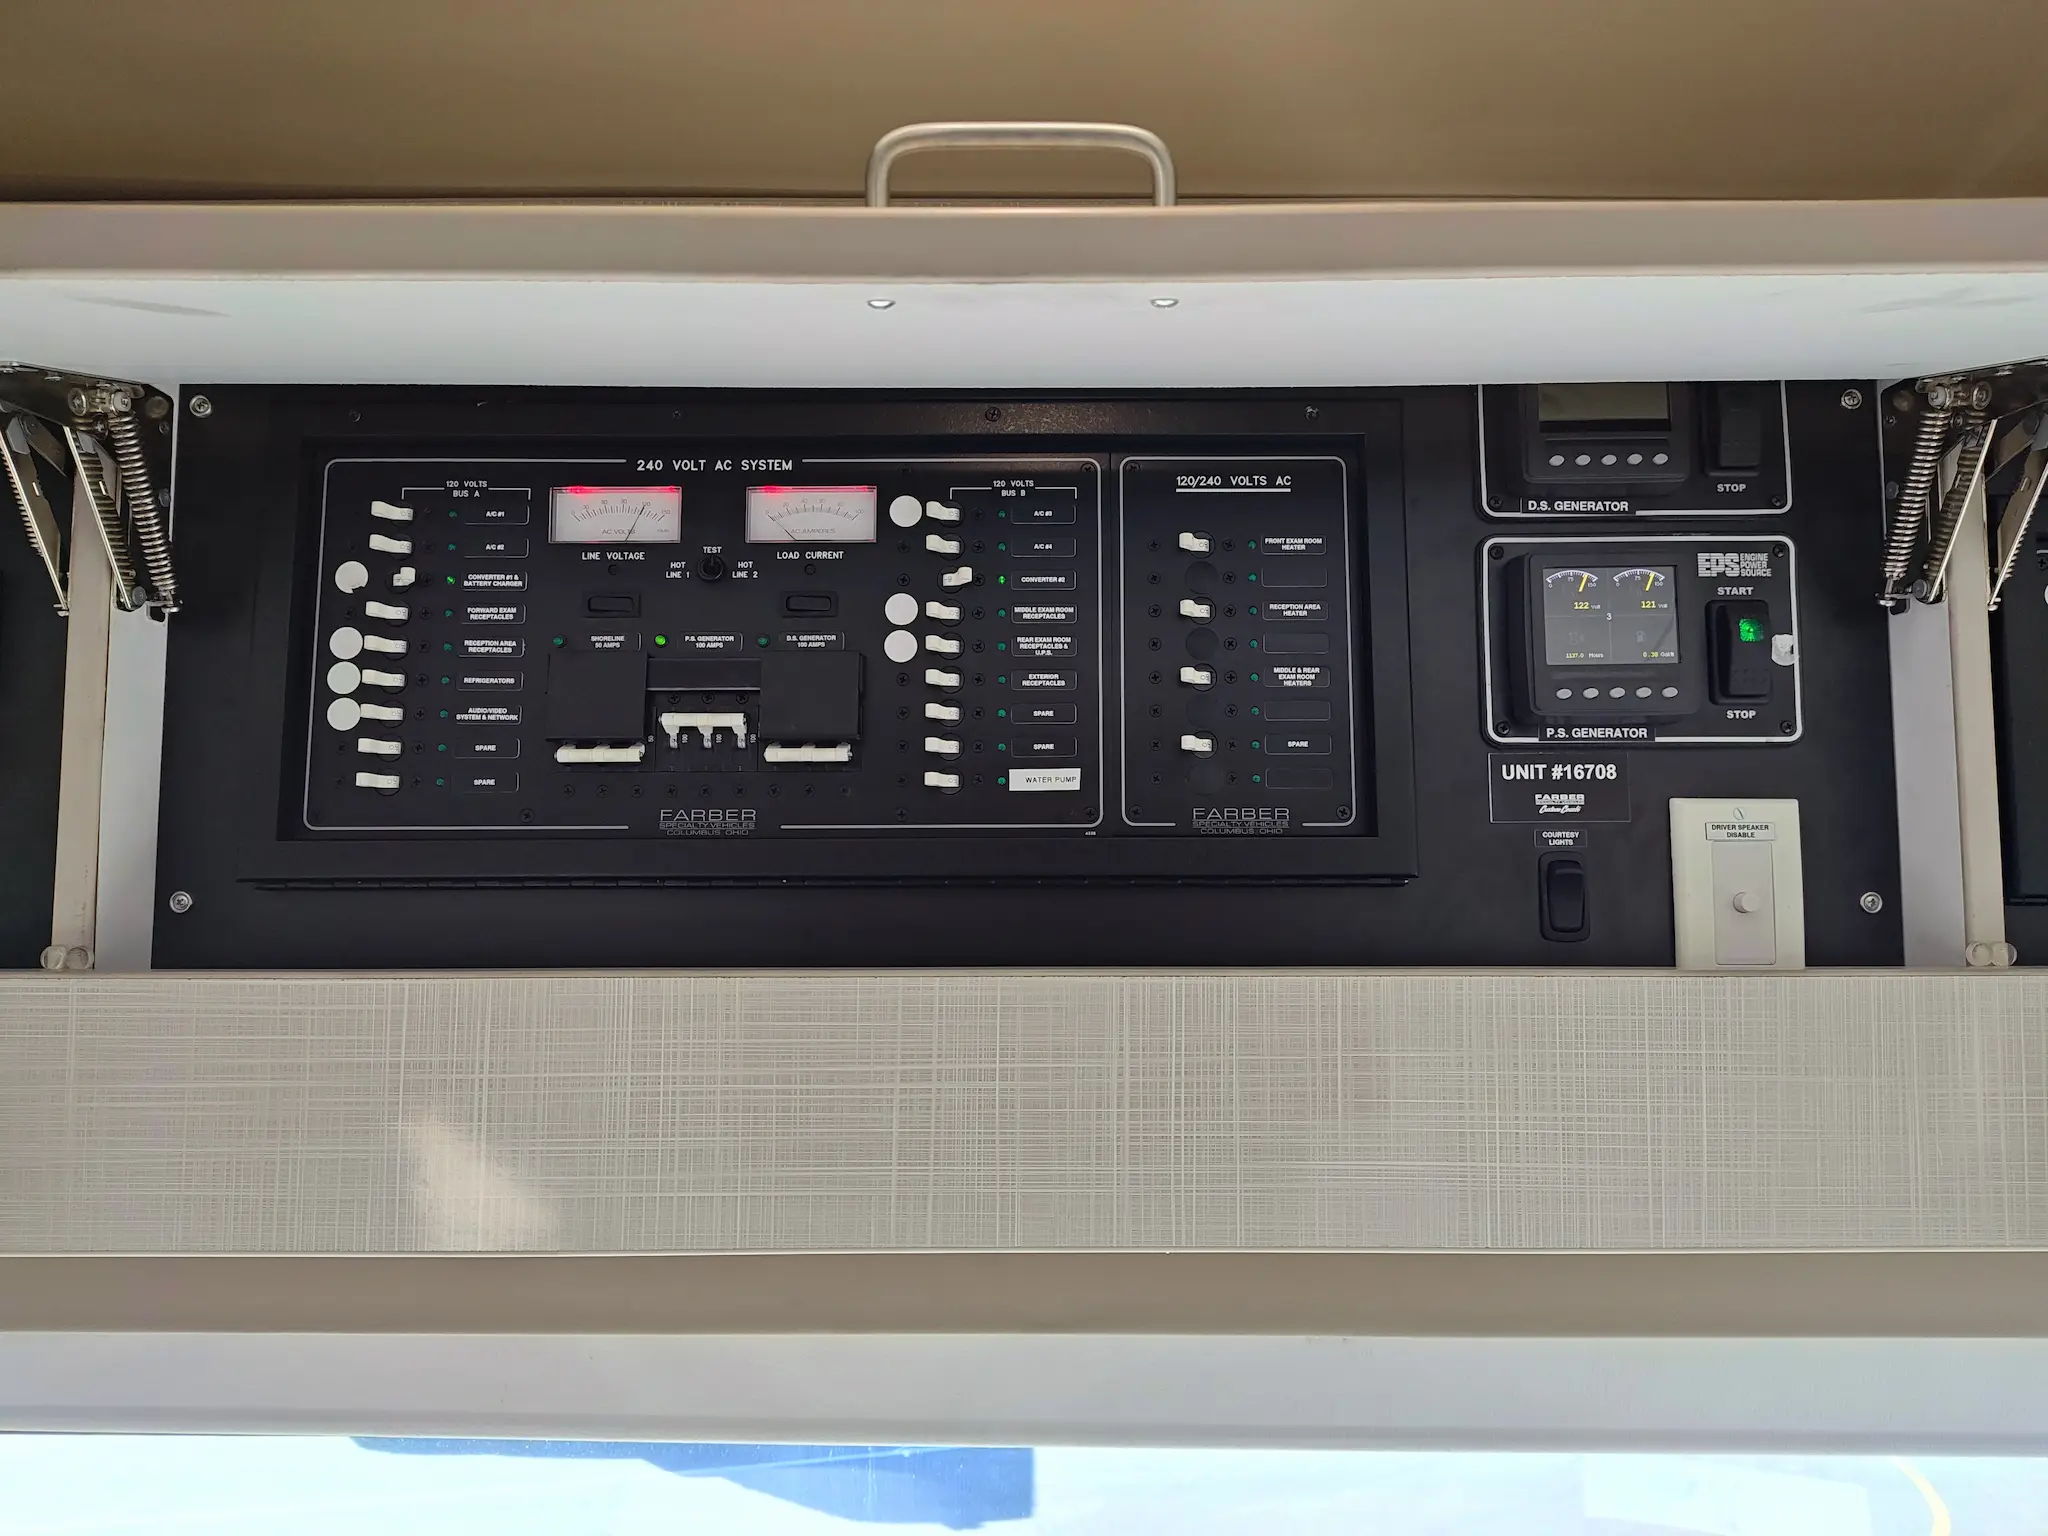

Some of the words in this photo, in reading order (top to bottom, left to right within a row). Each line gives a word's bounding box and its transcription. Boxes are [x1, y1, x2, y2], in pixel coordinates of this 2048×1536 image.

[637, 460, 663, 471] 240
[673, 460, 706, 471] VOLT
[715, 460, 732, 471] AC
[741, 459, 792, 470] SYSTEM
[1176, 476, 1221, 488] 120/240
[1230, 476, 1267, 486] VOLTS
[1276, 476, 1291, 485] AC
[1717, 484, 1746, 492] STOP
[1528, 501, 1551, 511] D.S.
[1554, 501, 1628, 511] GENERATOR
[582, 552, 600, 560] LINE
[606, 552, 645, 560] VOLTAGE
[777, 551, 800, 559] LOAD
[805, 551, 844, 559] CURRENT
[1739, 553, 1768, 562] ENGINE
[1697, 553, 1740, 576] EPS
[1739, 561, 1767, 569] POWER
[1739, 568, 1771, 577] SOURCE
[493, 580, 523, 588] CHARGER
[1717, 587, 1754, 595] START
[1641, 601, 1656, 609] 121
[1606, 612, 1612, 621] 3
[488, 713, 519, 721] NETWORK
[1727, 710, 1756, 719] STOP
[1547, 728, 1569, 738] P.S.
[1572, 728, 1647, 738] GENERATOR
[648, 735, 655, 743] 50
[1502, 764, 1547, 780] UNIT
[1551, 764, 1617, 780] #16708
[660, 809, 756, 821] FARBER
[1193, 808, 1289, 819] FARBER
